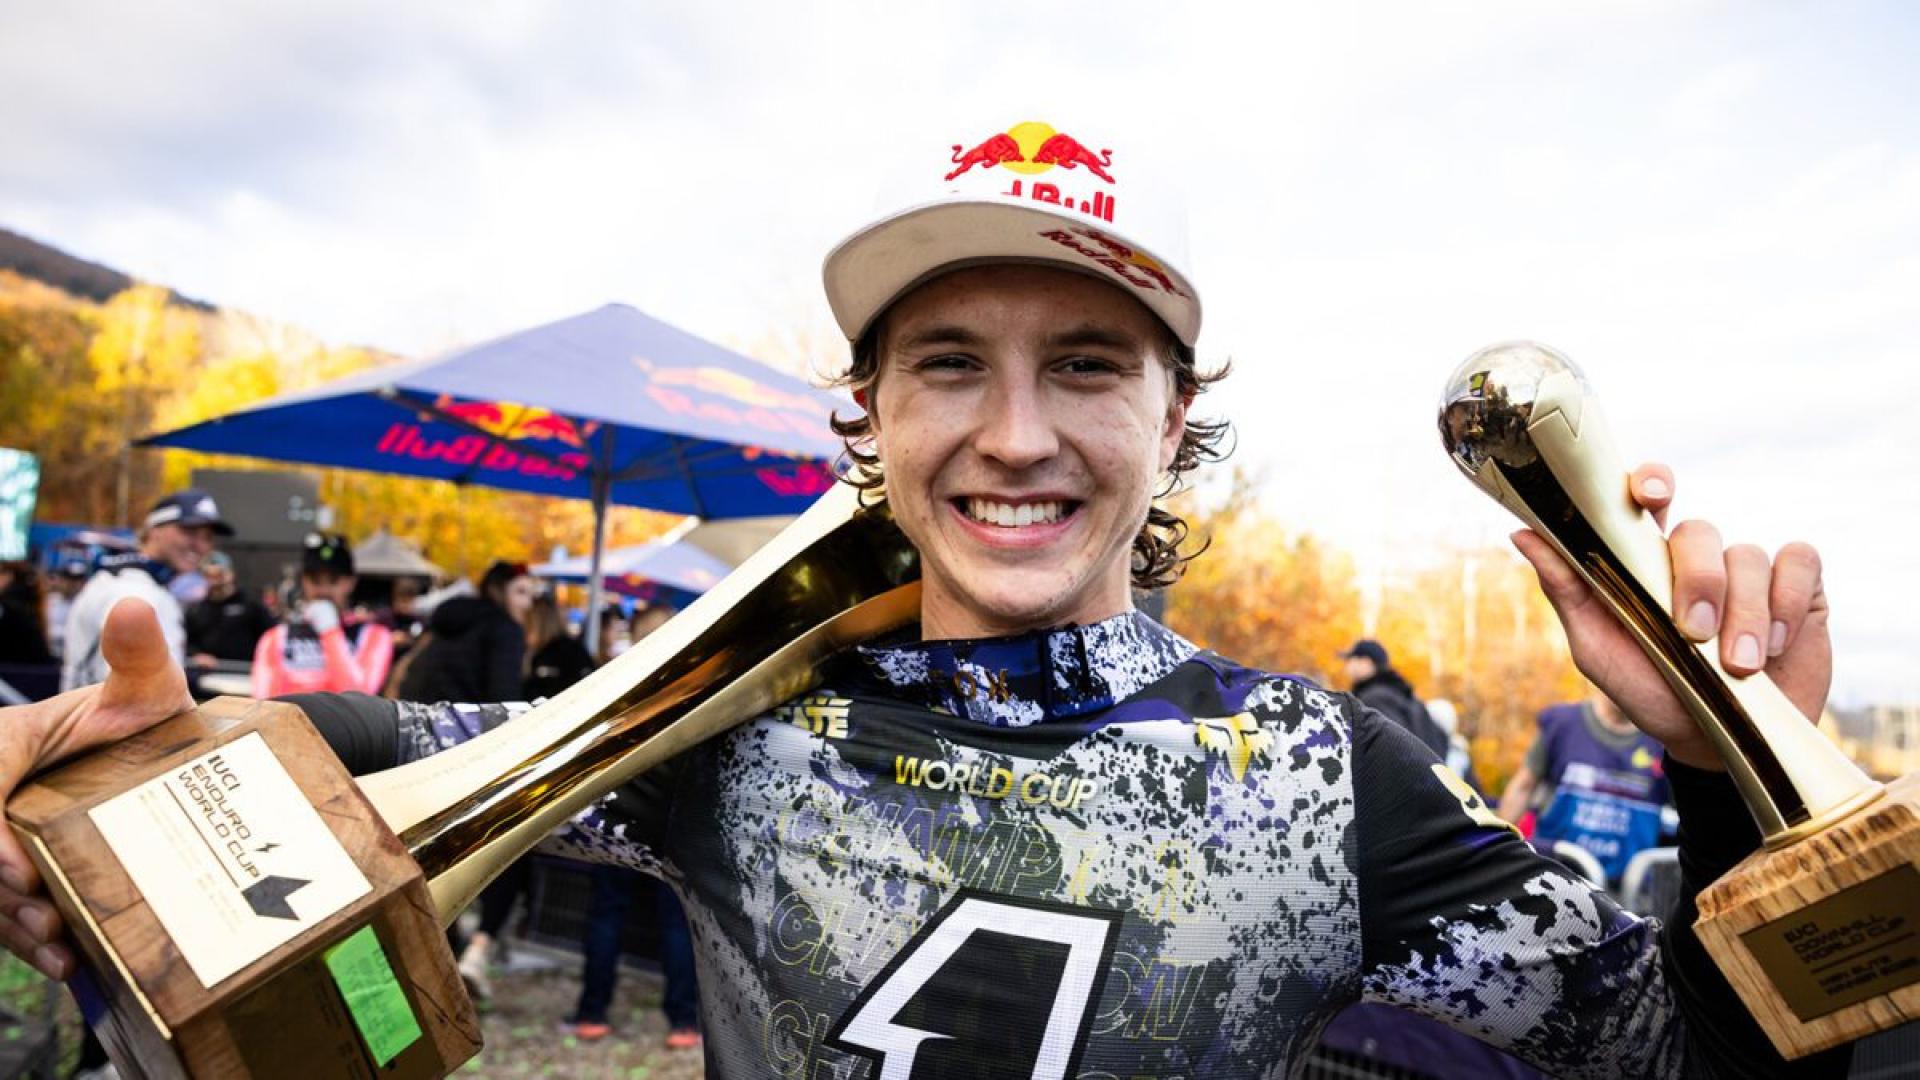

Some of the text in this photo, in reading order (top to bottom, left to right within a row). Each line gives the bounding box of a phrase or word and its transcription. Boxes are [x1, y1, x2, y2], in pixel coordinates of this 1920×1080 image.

[192, 763, 251, 841] ENDURO
[895, 754, 1099, 810] WORLD CUP
[178, 770, 231, 838] WORLD
[226, 839, 261, 879] CUP
